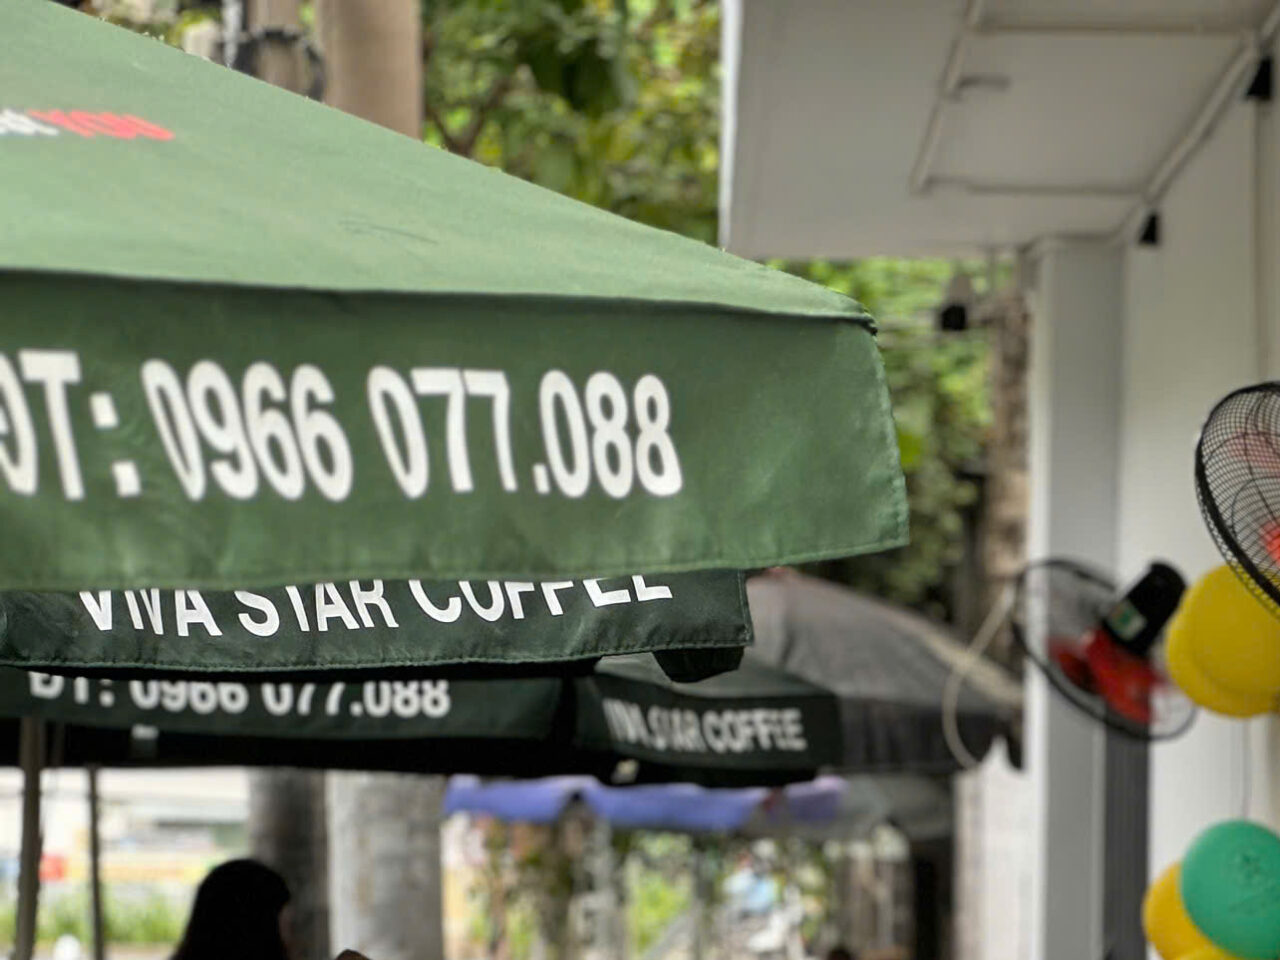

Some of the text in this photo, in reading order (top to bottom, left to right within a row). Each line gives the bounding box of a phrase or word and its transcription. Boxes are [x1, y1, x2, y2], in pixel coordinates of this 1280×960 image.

[140, 359, 354, 501] 0966
[367, 366, 683, 499] 077.088
[79, 588, 223, 637] VIVA
[234, 579, 399, 637] STAR
[129, 680, 249, 714] 0966
[261, 681, 451, 718] 077.088
[703, 707, 808, 753] COFFEE
